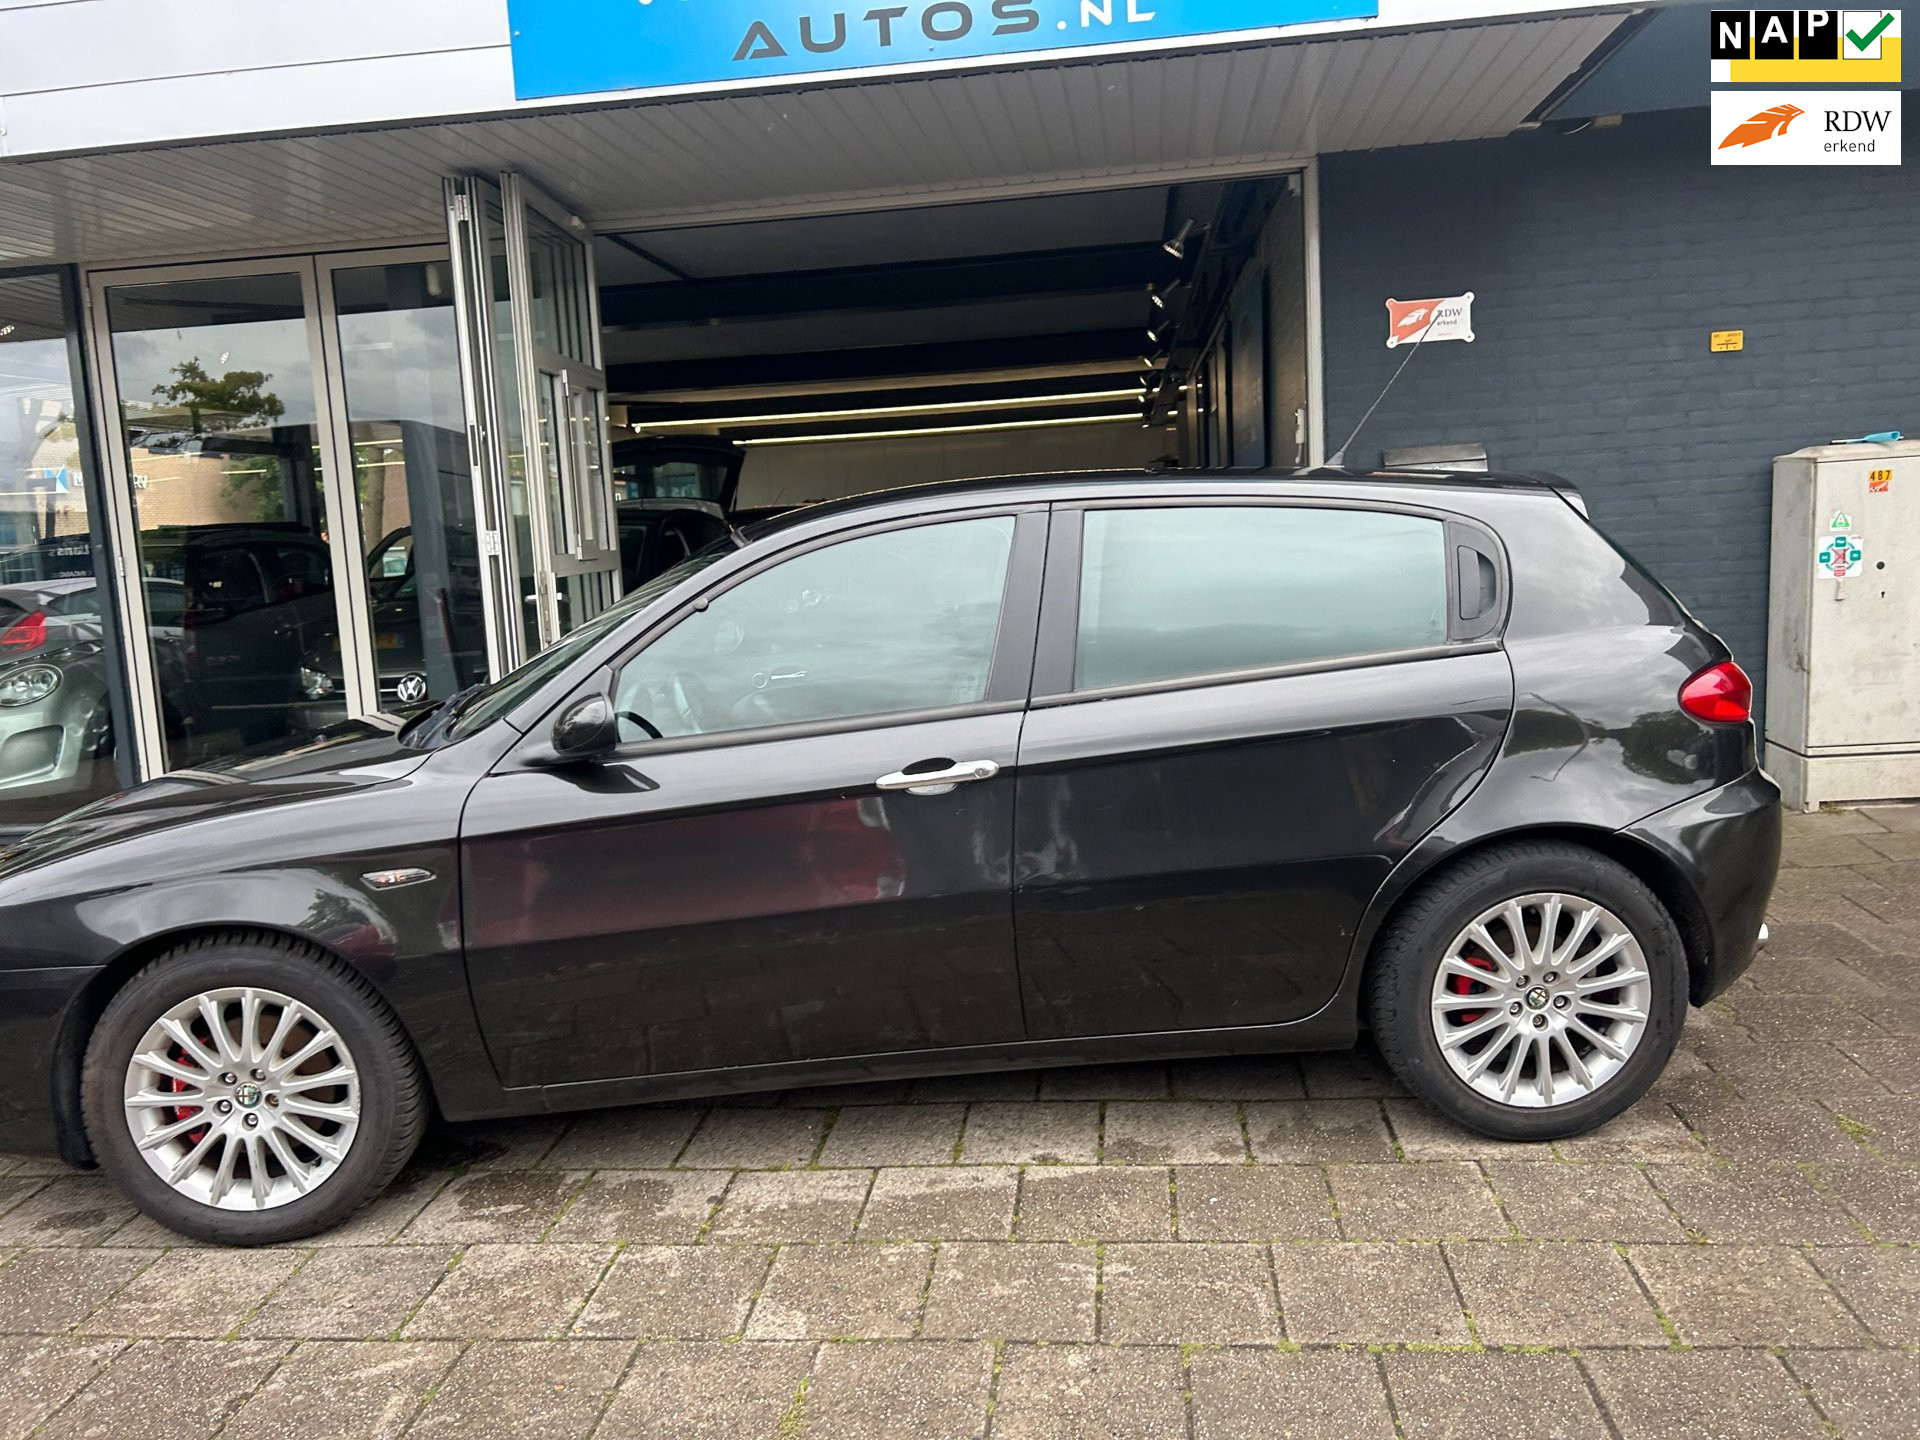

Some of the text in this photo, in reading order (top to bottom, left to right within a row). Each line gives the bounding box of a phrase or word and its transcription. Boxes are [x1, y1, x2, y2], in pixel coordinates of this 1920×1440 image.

[731, 0, 1157, 62] AUTOS.NL
[1437, 308, 1462, 318] RDW
[1869, 470, 1890, 481] 487
